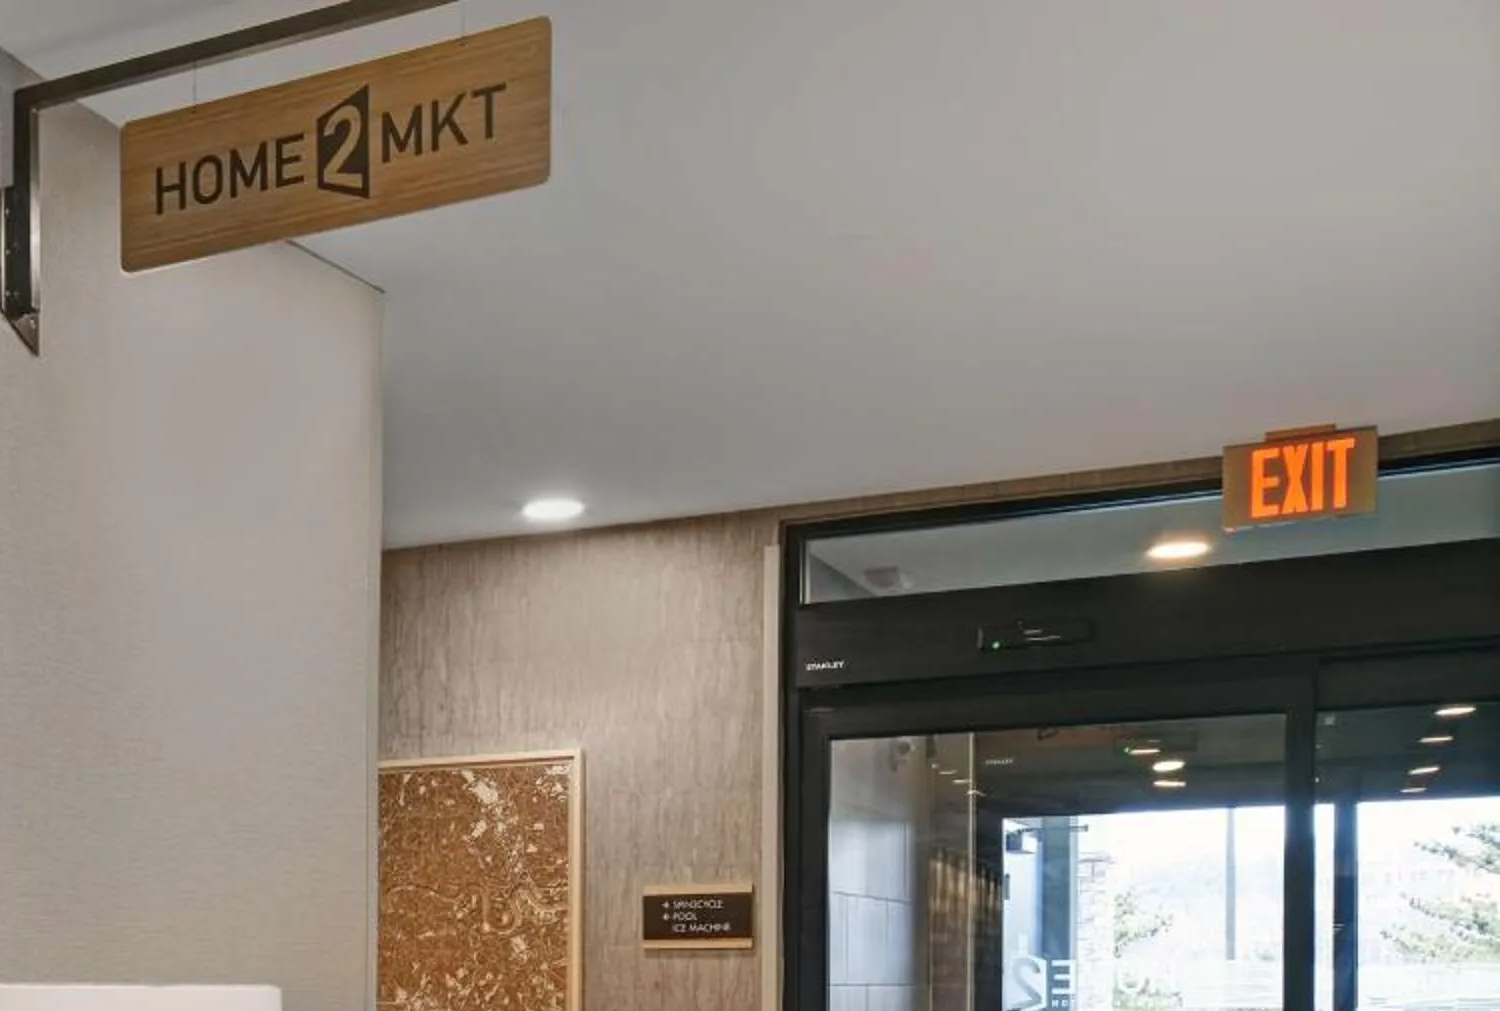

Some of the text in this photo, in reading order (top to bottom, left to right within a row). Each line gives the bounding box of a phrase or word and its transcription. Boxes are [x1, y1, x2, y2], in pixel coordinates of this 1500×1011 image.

[155, 133, 305, 215] HOME
[381, 83, 507, 164] MKT
[1251, 437, 1356, 519] EXIT
